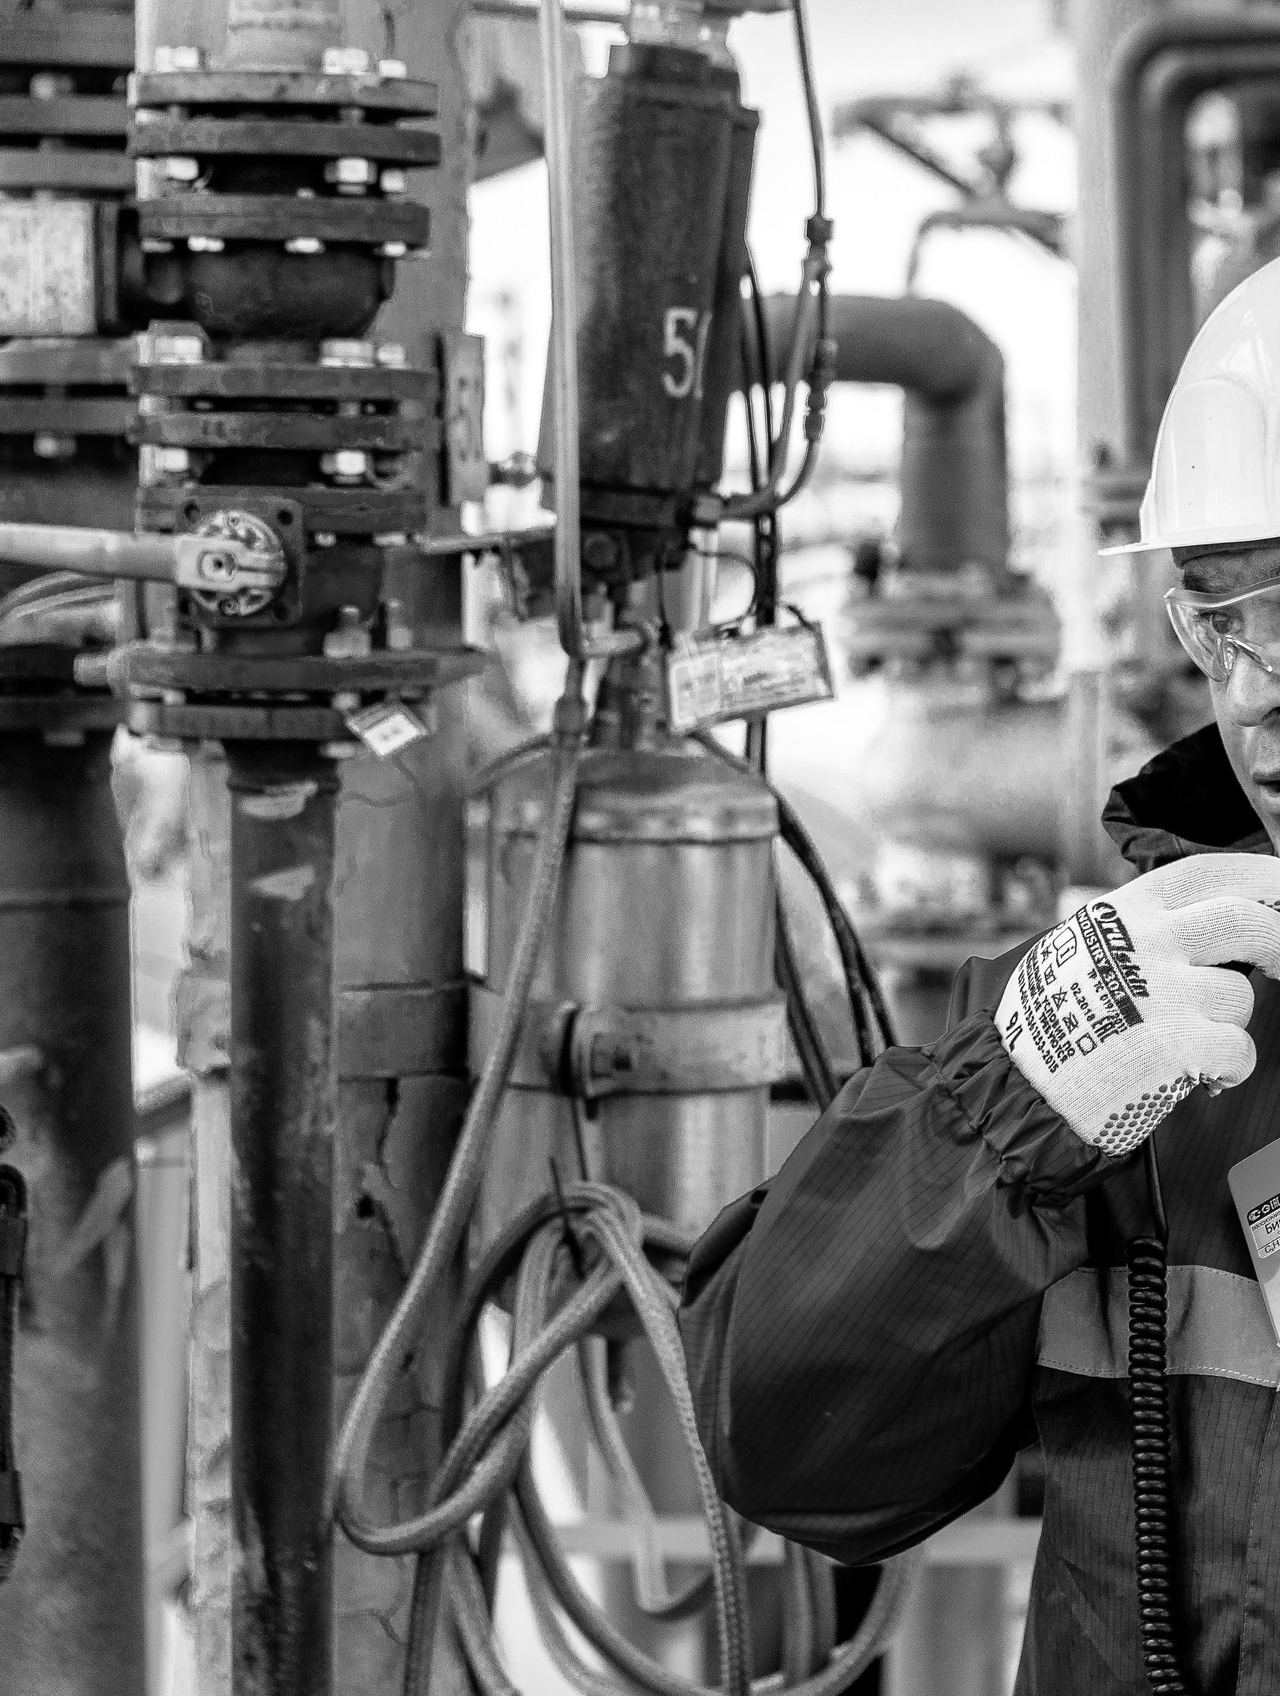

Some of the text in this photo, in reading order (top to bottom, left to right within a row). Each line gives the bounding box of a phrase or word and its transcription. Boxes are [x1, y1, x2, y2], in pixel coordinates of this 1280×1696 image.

[1076, 908, 1125, 998] INDUSTRY 304
[1042, 995, 1066, 1041] УСЛОВИЯ
[1062, 1041, 1076, 1058] ПО
[1070, 982, 1096, 1022] 02.2018
[1005, 1011, 1023, 1052] 9/L
[1039, 1012, 1069, 1065] ТРЕБУЮТСЯ
